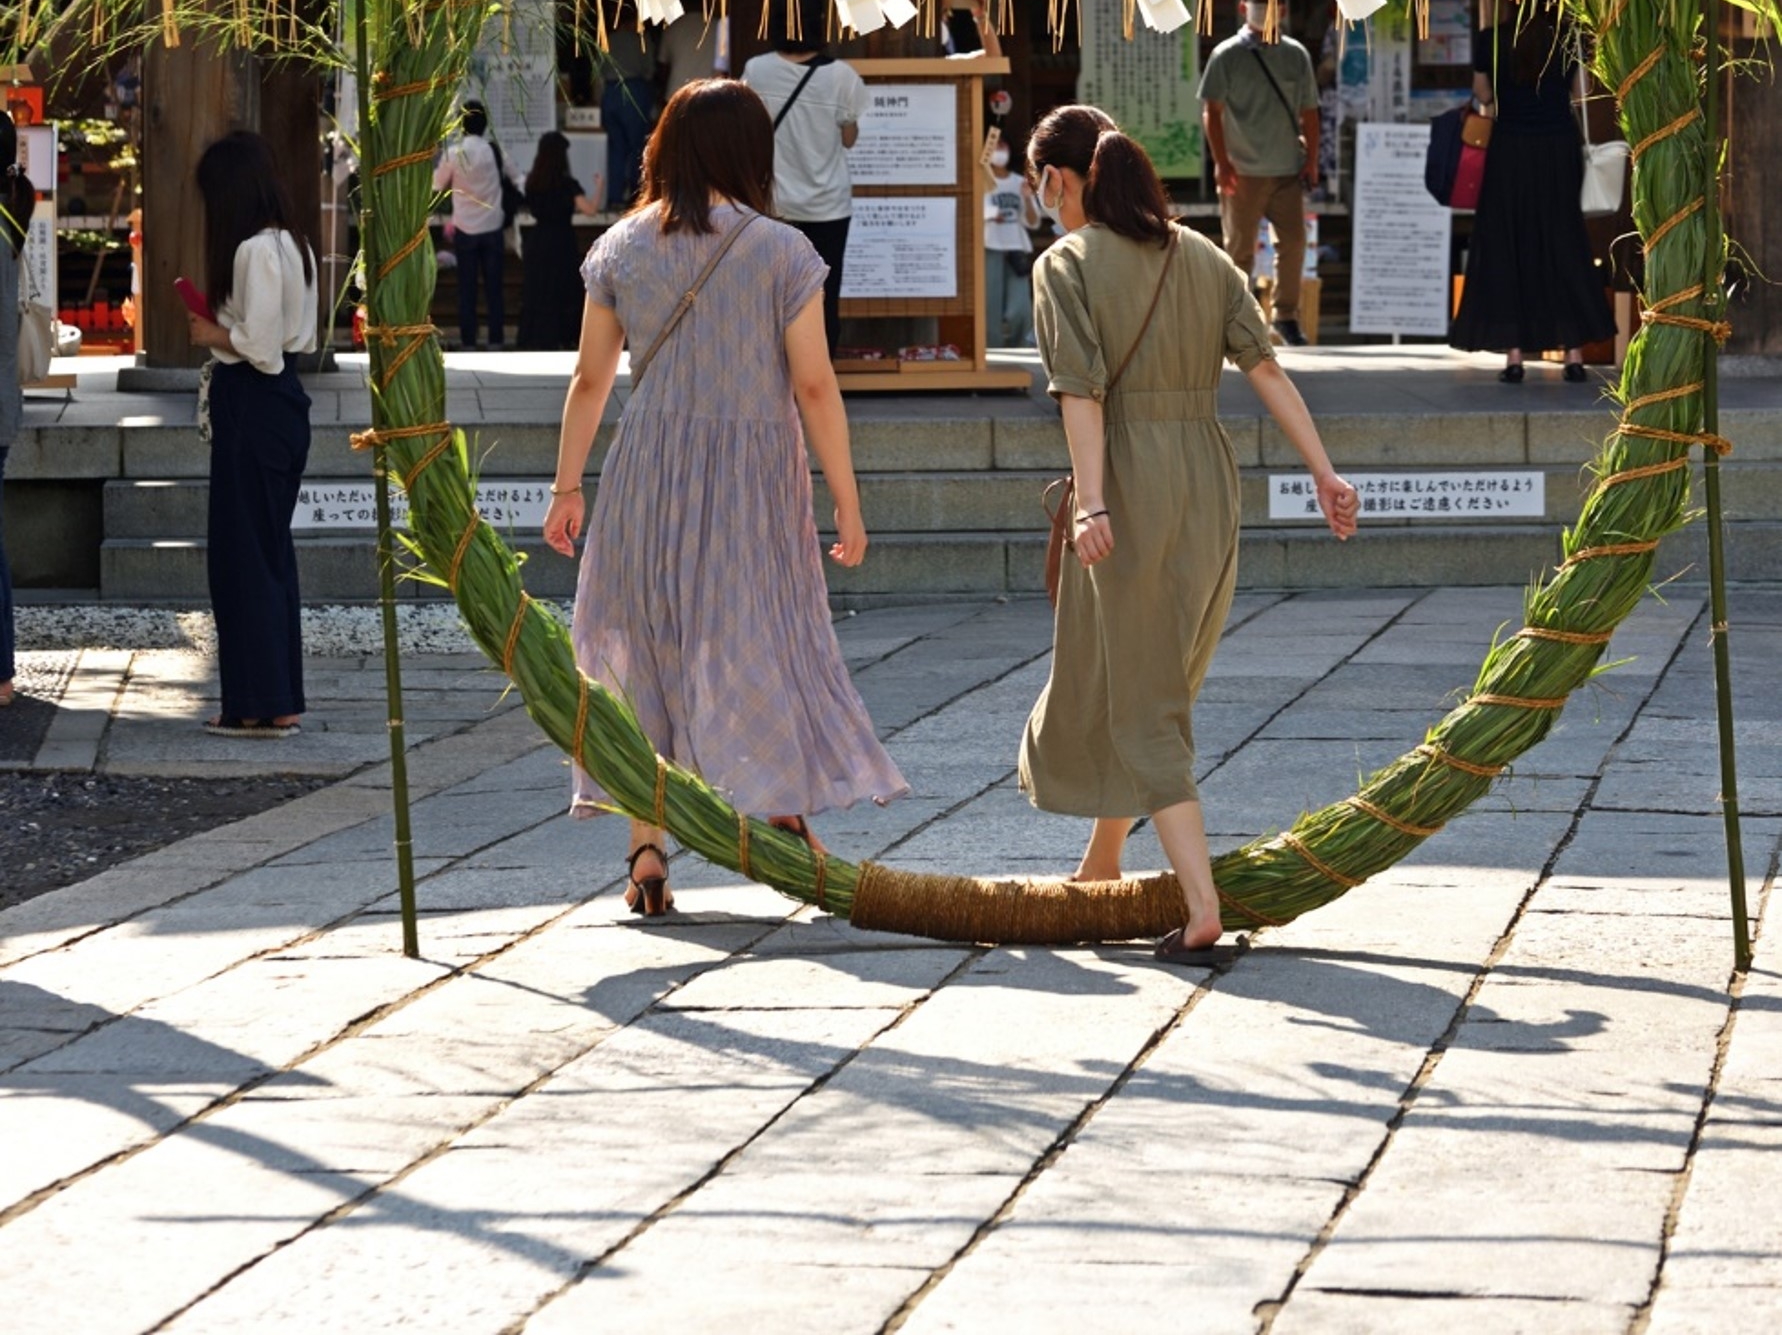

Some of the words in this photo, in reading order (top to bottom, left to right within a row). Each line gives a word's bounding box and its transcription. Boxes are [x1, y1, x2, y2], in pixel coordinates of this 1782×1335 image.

[1280, 478, 1534, 495] お越しいた方に楽しんでいただけるよう
[1304, 497, 1510, 512] 座撮影はご遠慮ください
